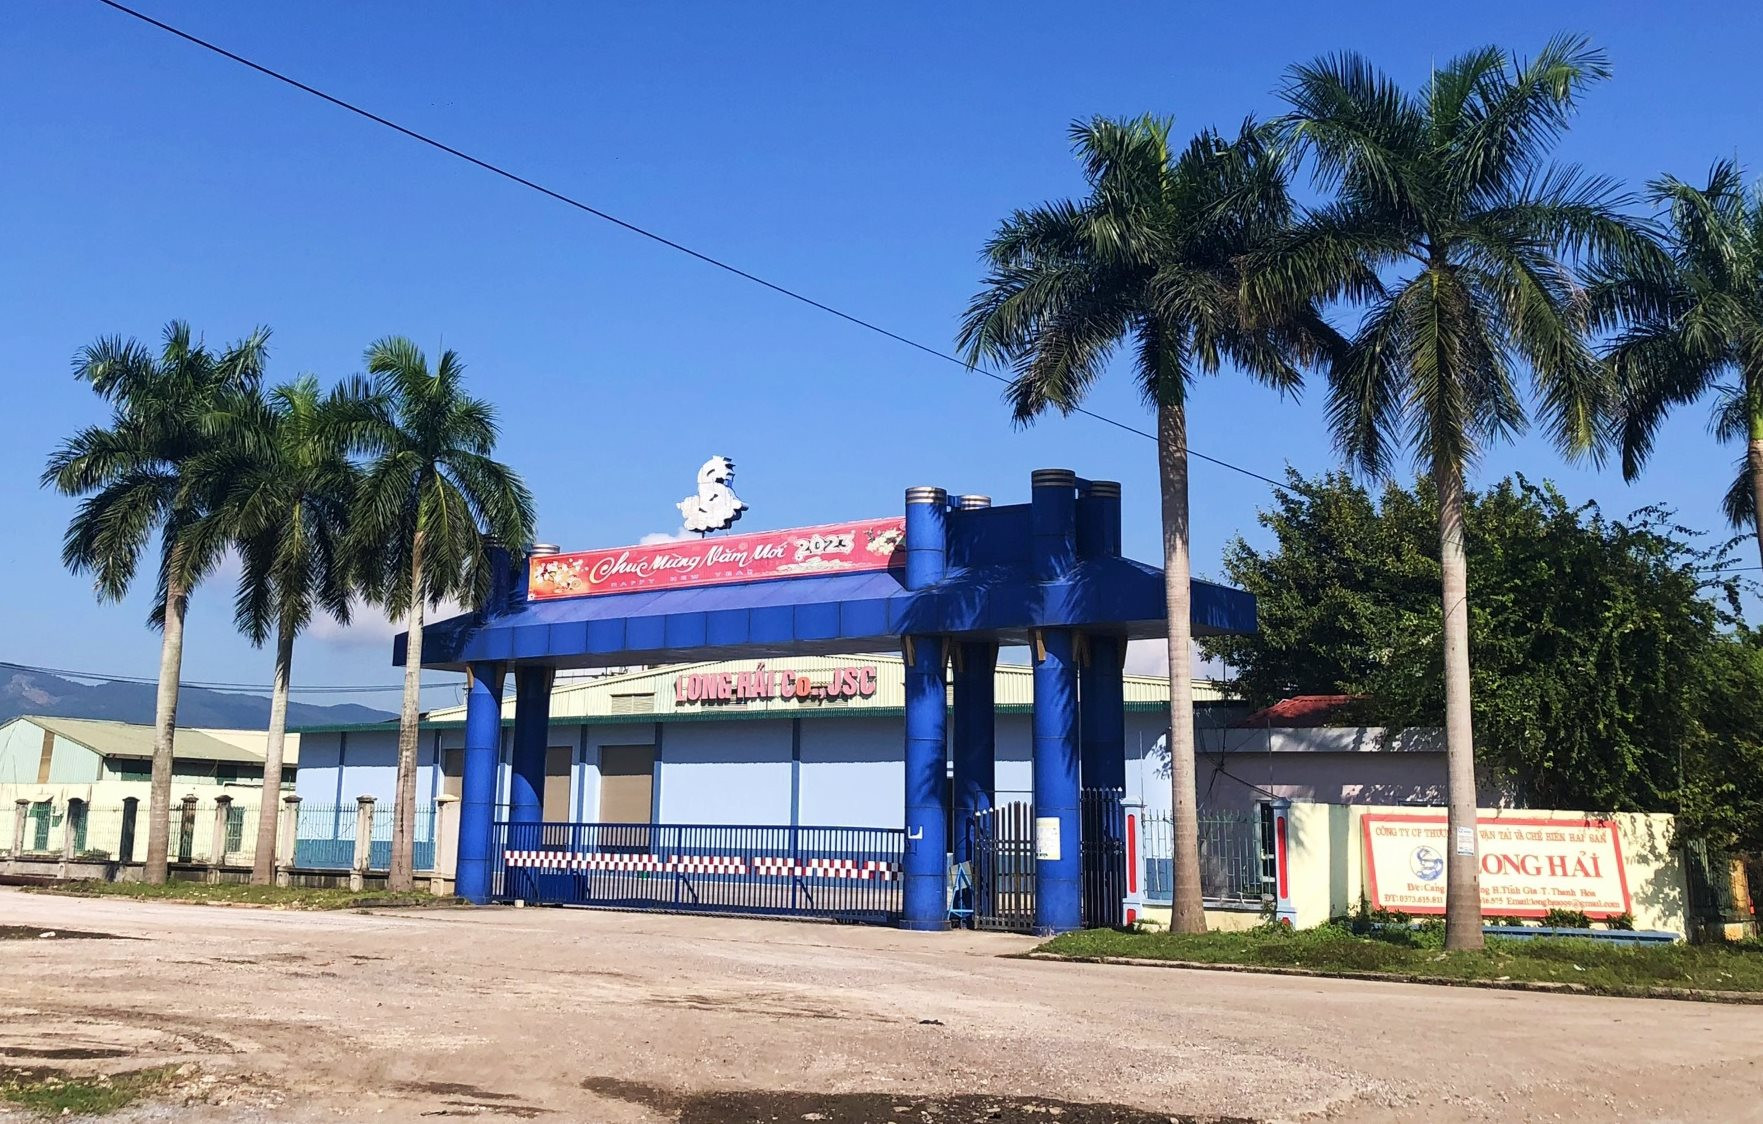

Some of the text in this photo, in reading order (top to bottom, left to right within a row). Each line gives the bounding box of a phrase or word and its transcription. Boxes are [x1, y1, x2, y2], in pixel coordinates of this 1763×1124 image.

[795, 531, 855, 562] 2023
[670, 574, 699, 582] NEW
[675, 671, 733, 702] LONG
[1375, 826, 1398, 837] CÔNG
[1399, 827, 1410, 837] TY
[1411, 828, 1422, 837] CP
[1513, 829, 1525, 841] VÀ
[1479, 853, 1543, 876] ONG
[1522, 886, 1537, 895] Gia
